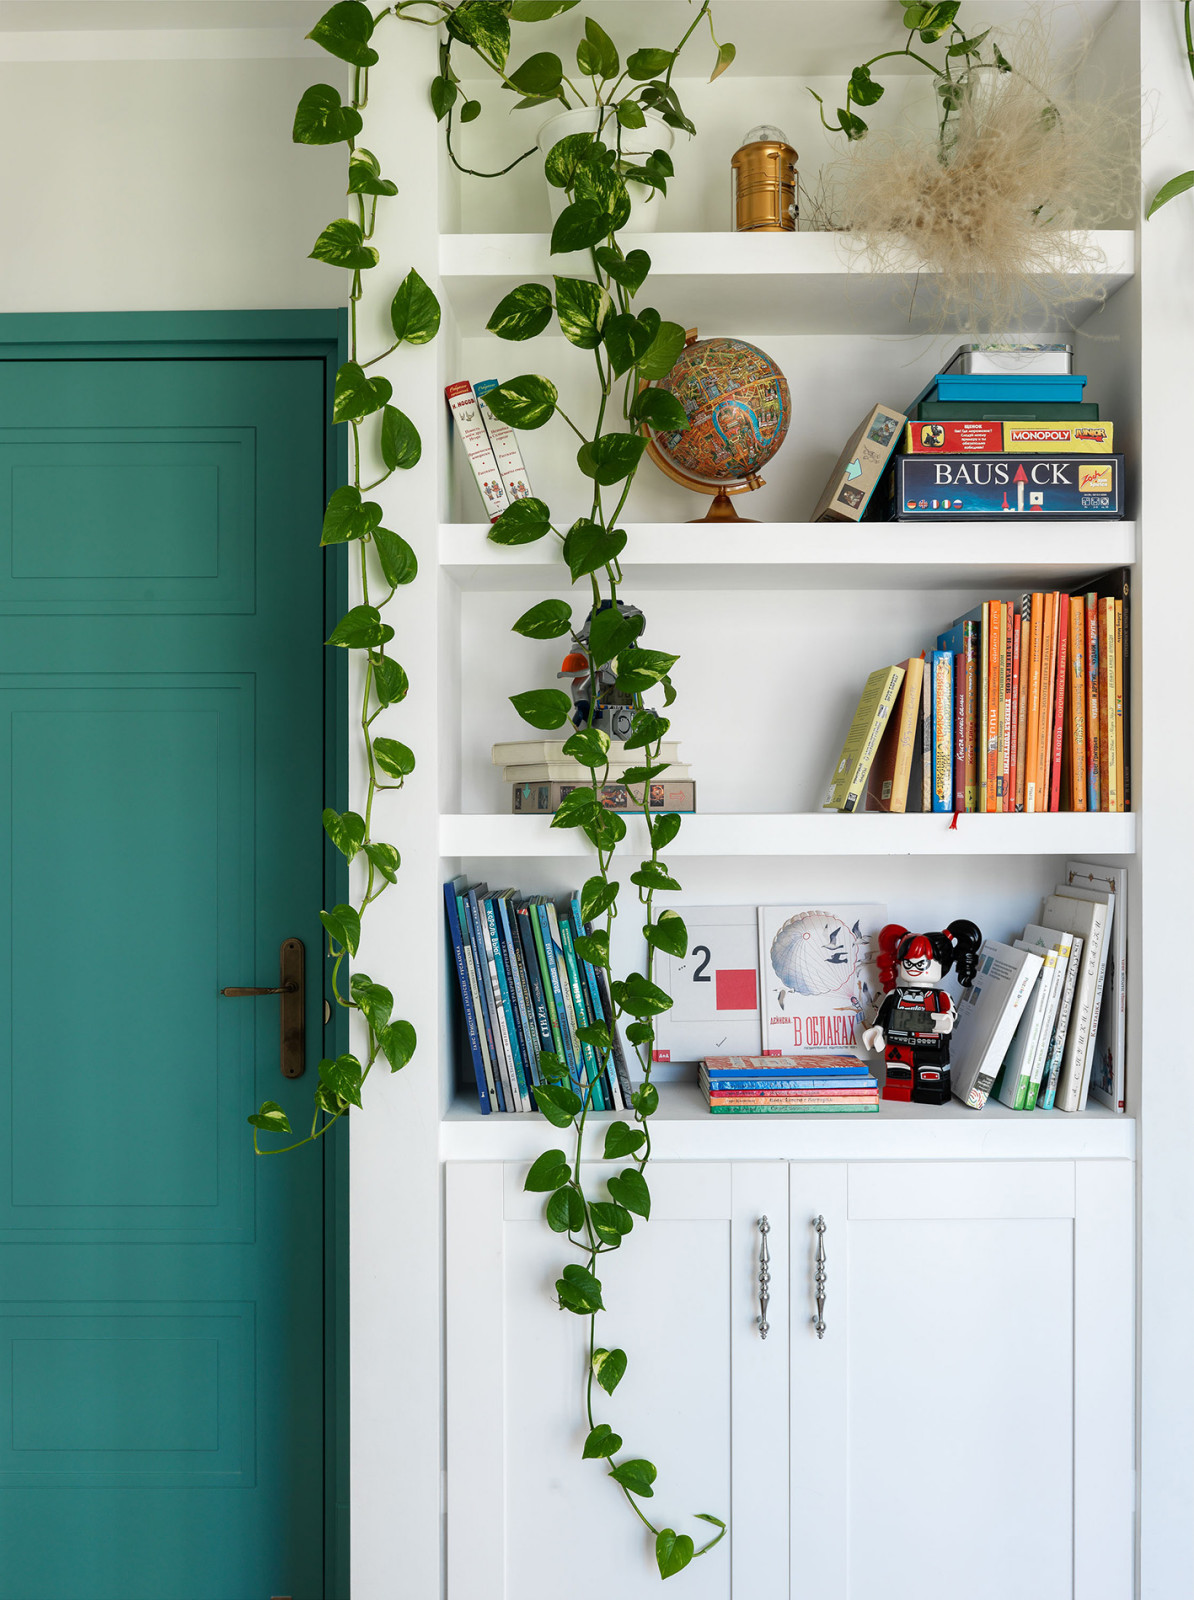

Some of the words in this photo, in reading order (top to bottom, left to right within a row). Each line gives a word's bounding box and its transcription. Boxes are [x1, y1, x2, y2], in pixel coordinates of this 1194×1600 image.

[1013, 431, 1070, 440] MONOPOLY
[1075, 428, 1106, 438] JUNIOR
[487, 910, 496, 936] КОРОЛЬ
[492, 937, 500, 956] ВЬЮГ
[456, 945, 465, 975] РУСАЛОЧКА
[502, 941, 510, 975] ПОРТНЯЖКА
[692, 945, 711, 982] 2
[462, 980, 471, 1008] АНДЕРСЕН
[466, 1010, 475, 1036] ХРИСТИАН
[793, 1017, 802, 1046] В
[806, 1016, 857, 1046] ОБЛАКАХ
[1091, 1001, 1100, 1037] КАШТАНКА
[1076, 1005, 1089, 1067] ПУШКИН
